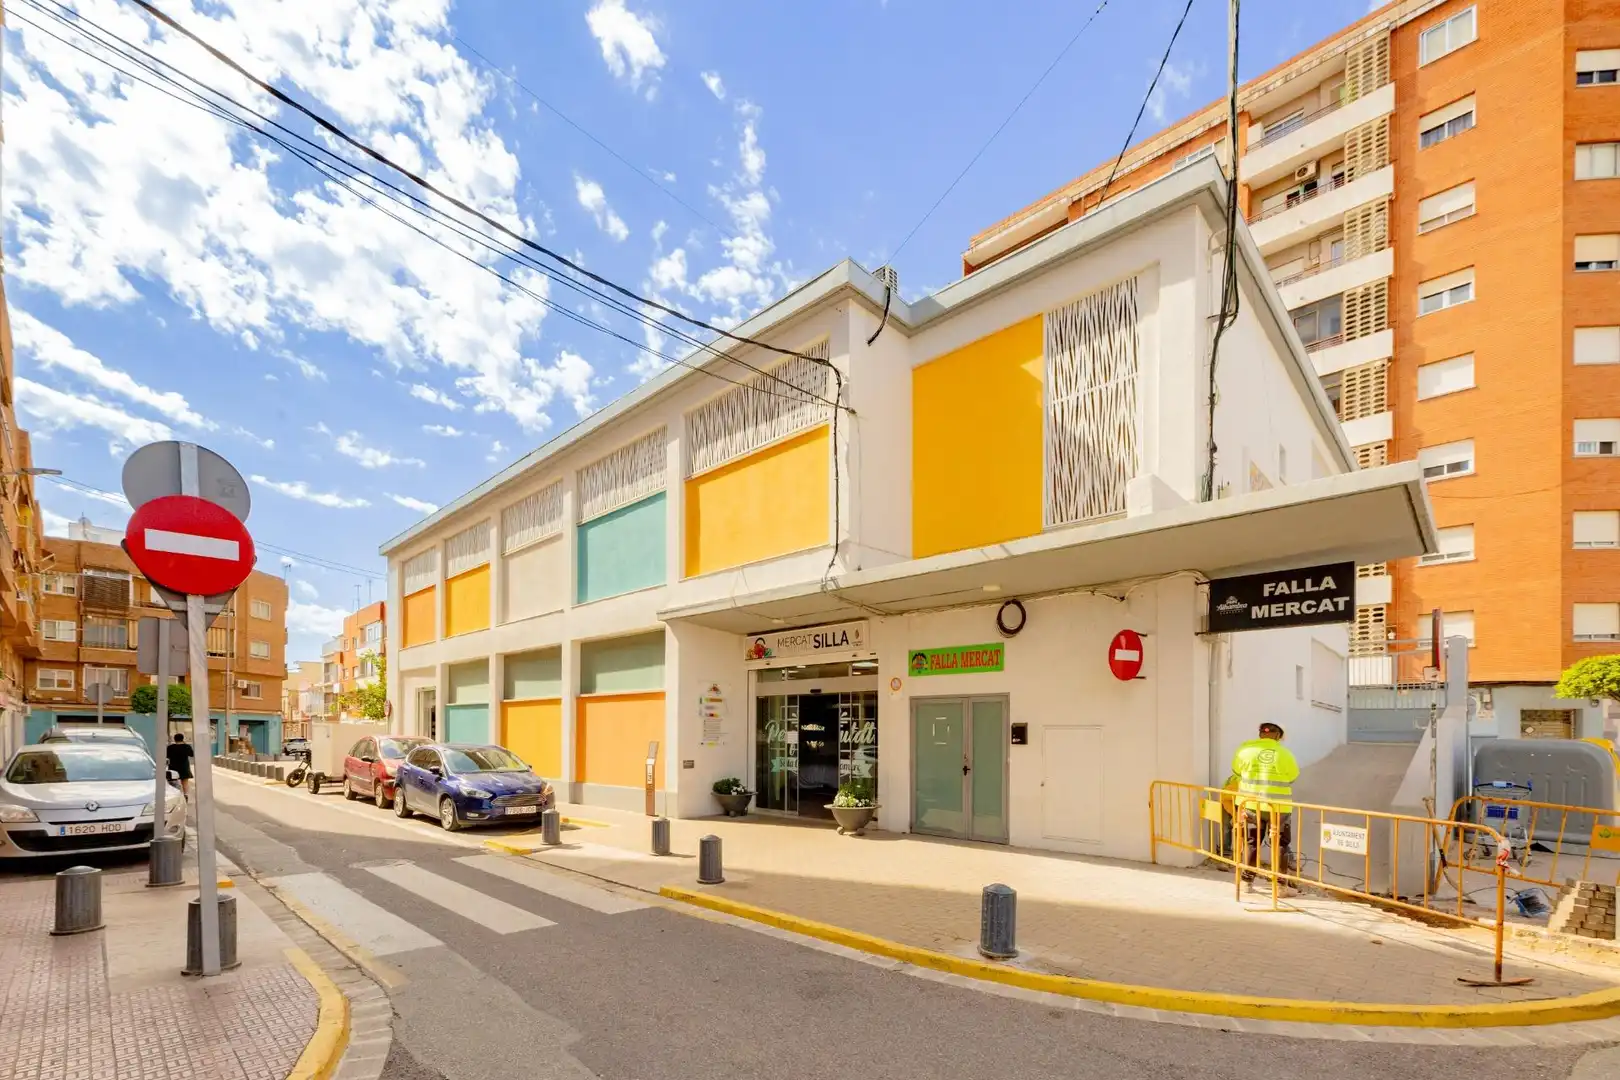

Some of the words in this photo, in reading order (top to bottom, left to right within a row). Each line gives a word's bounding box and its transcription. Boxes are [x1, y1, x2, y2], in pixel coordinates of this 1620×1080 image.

[1263, 576, 1337, 597] FALLA
[1251, 596, 1350, 619] MERCAT
[777, 634, 812, 648] MERCAT
[813, 630, 849, 649] SILLA
[930, 653, 958, 670] FALLA
[961, 649, 1000, 668] MERCAT
[68, 825, 96, 834] 1620
